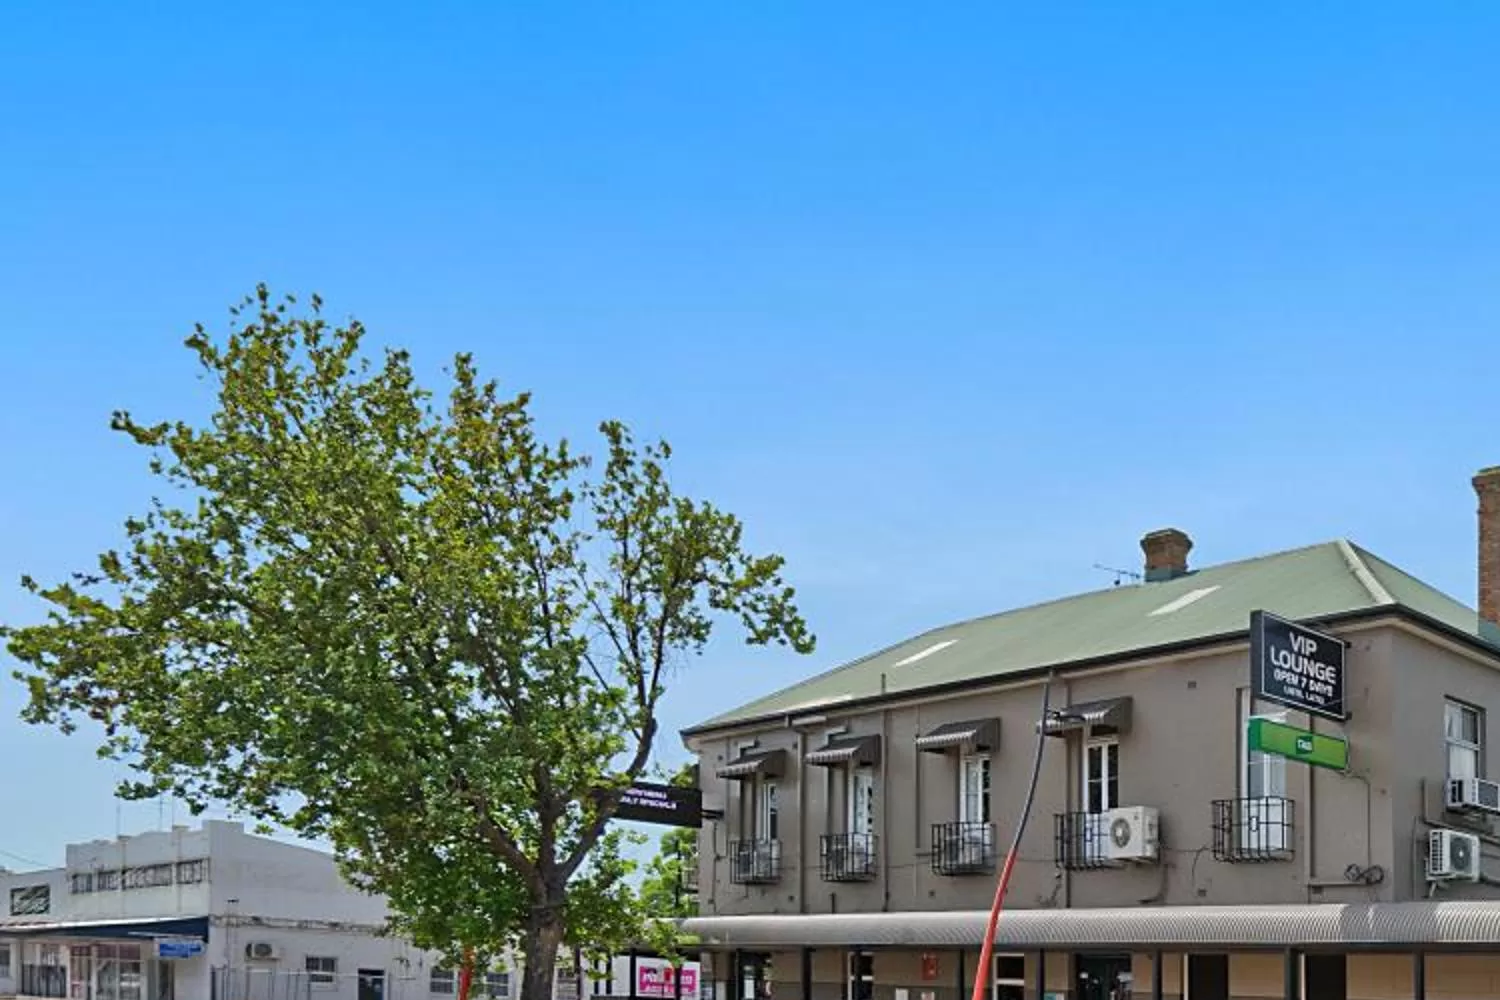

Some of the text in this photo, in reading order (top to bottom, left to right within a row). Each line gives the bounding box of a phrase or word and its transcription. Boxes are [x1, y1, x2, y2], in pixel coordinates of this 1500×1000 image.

[1289, 631, 1317, 656] VIP
[1270, 645, 1336, 685] LOUNGE
[1273, 668, 1333, 697] OPEN 7 DAYS
